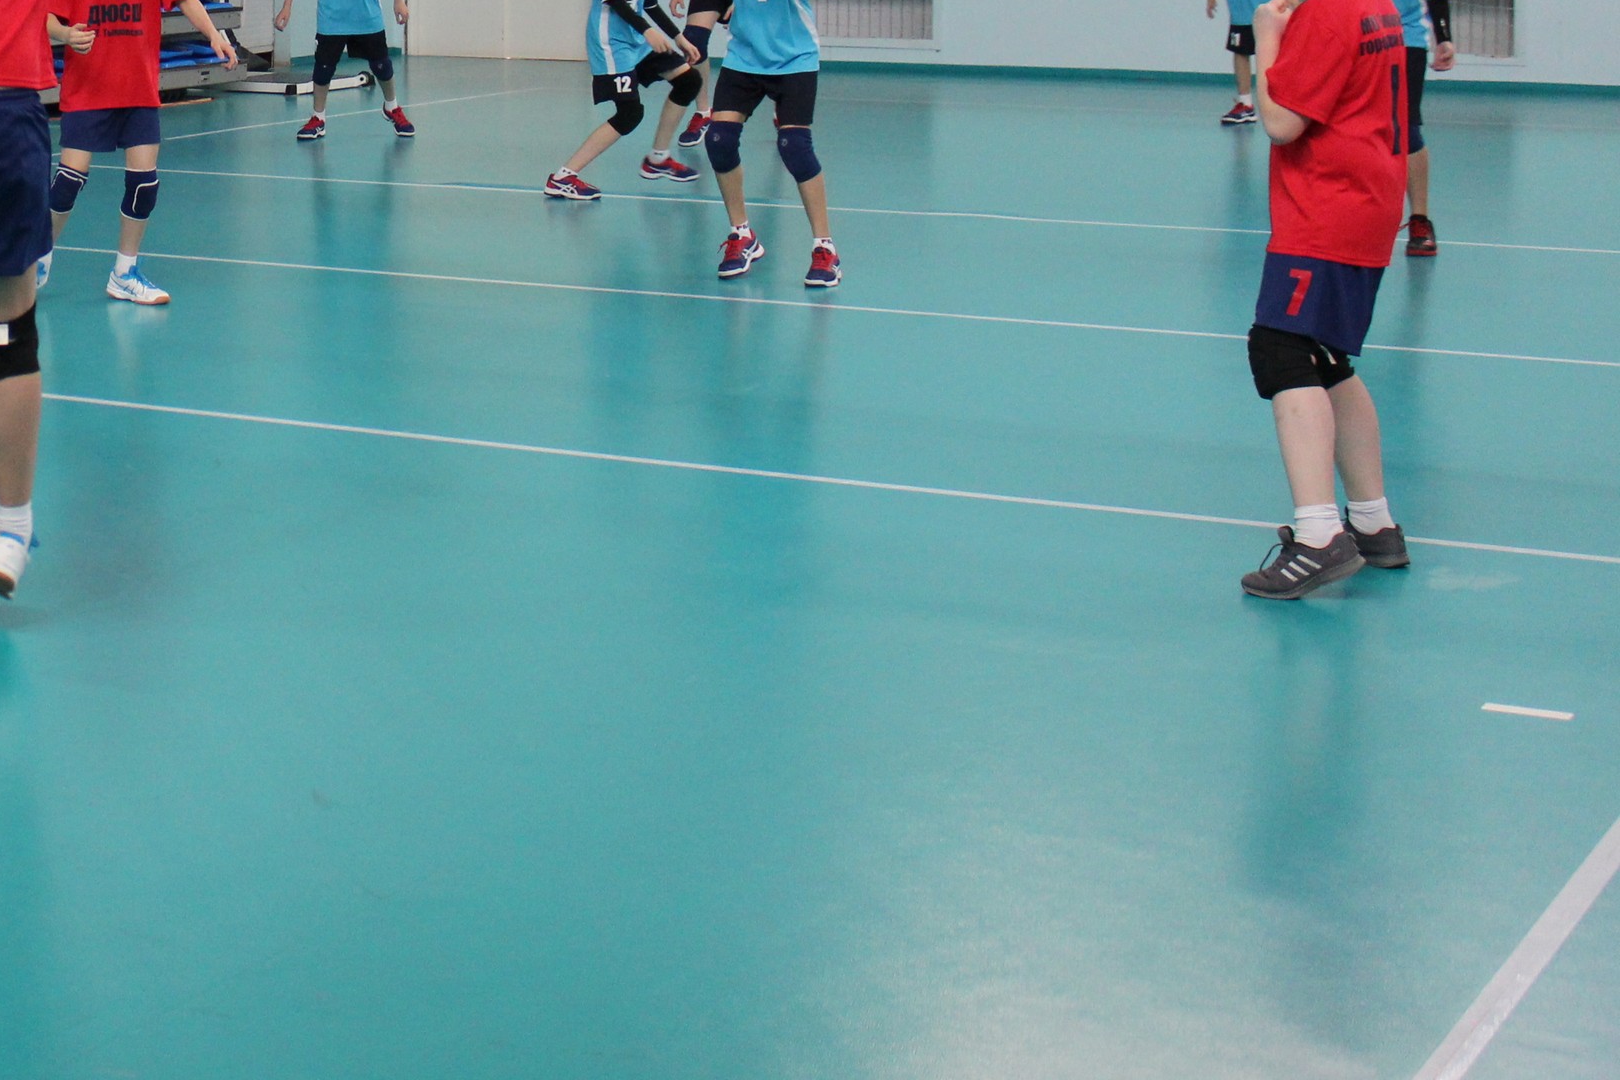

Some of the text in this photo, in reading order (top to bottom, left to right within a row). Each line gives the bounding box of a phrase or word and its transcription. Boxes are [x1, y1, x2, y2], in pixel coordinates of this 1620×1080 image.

[87, 2, 142, 27] ДЮСШ
[613, 75, 633, 94] 12
[1286, 268, 1313, 317] 7
